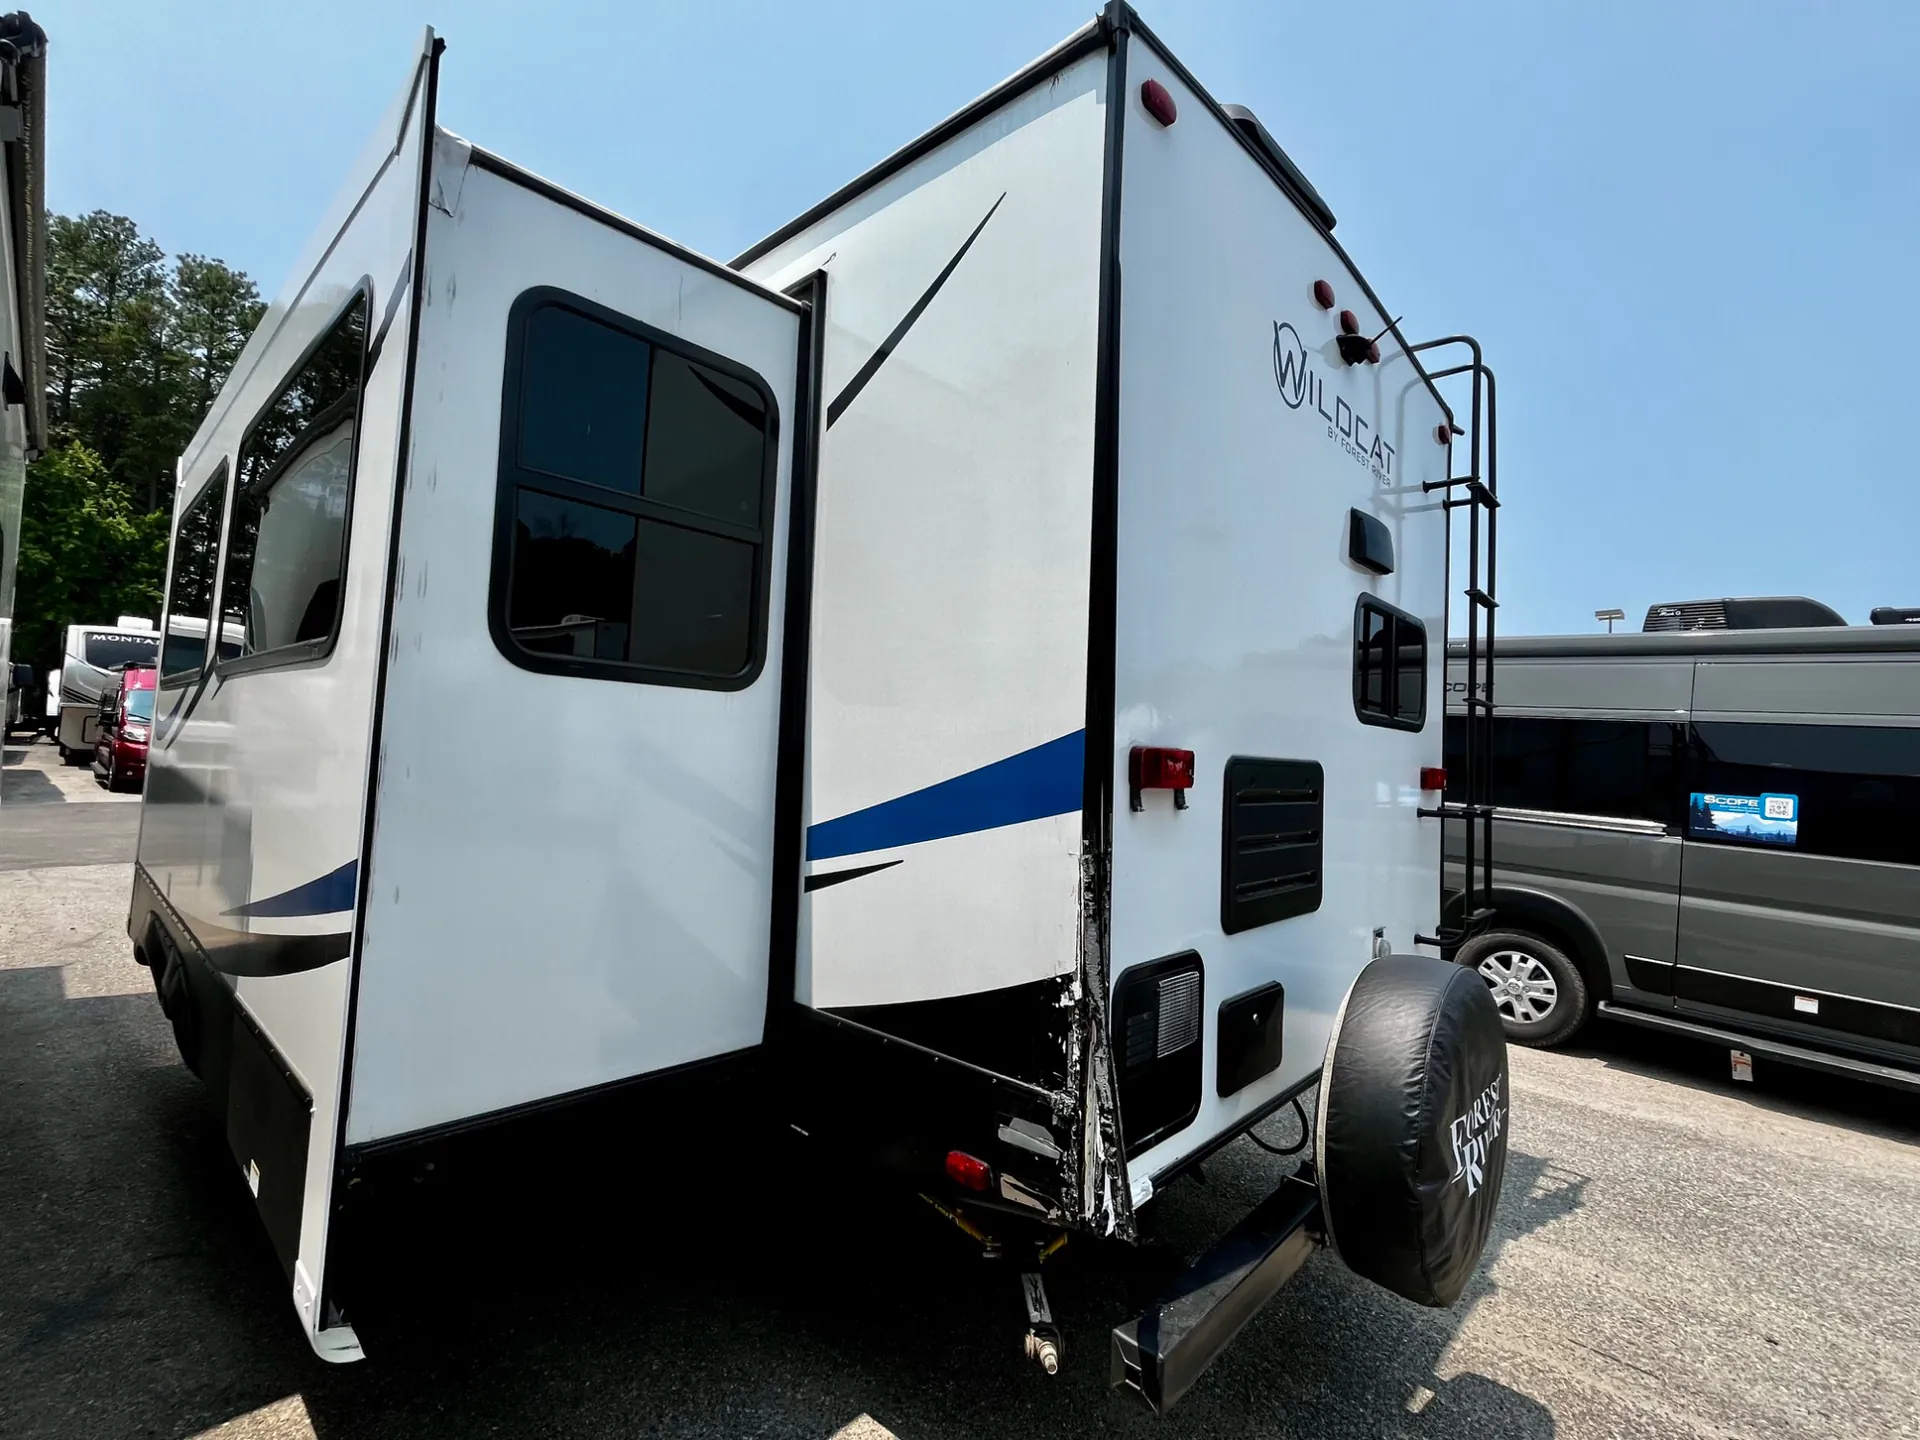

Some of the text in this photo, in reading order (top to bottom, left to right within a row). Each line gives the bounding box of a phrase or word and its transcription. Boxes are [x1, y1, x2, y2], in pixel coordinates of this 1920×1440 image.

[1273, 320, 1395, 474] WILDCAT
[1327, 426, 1391, 488] BY FOREST RIVER
